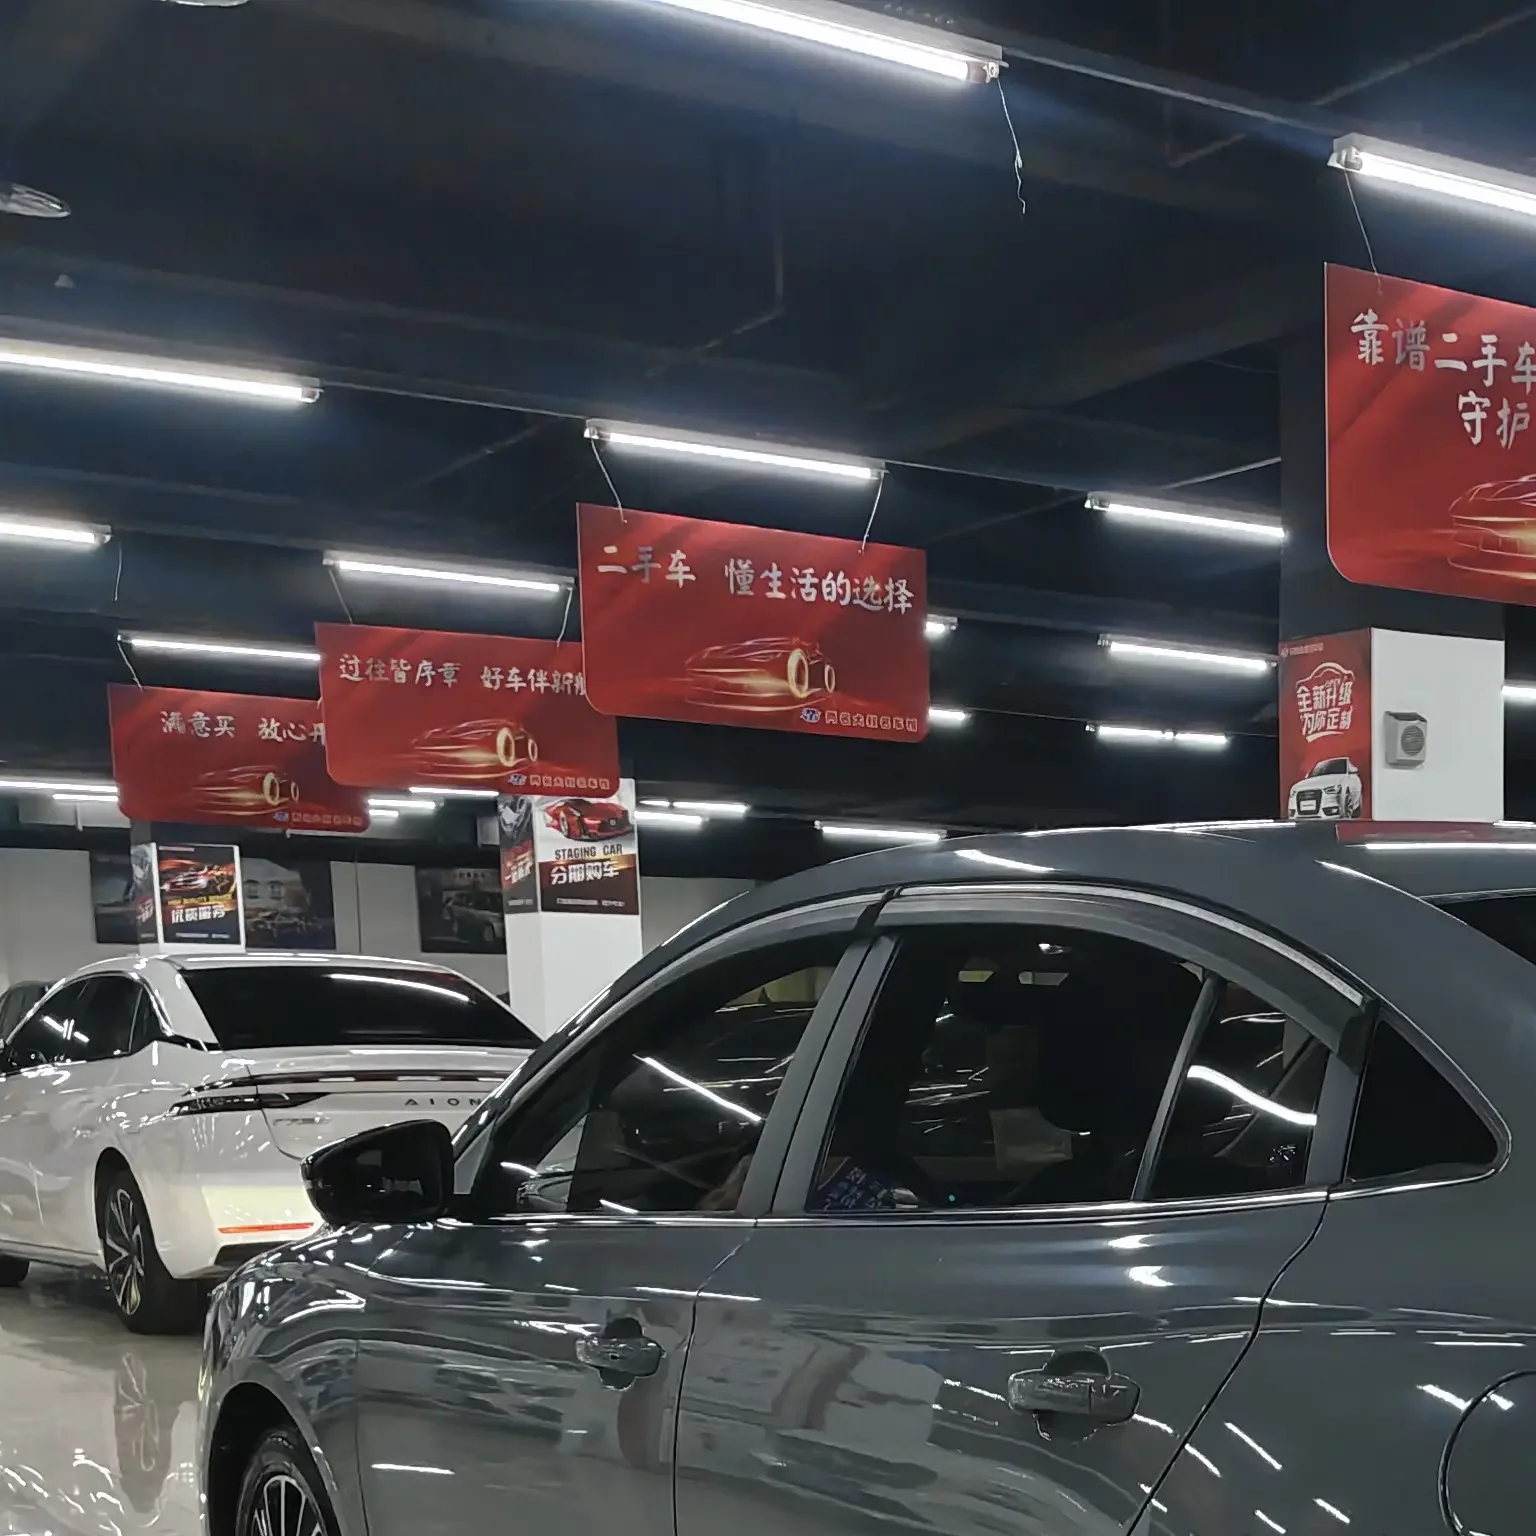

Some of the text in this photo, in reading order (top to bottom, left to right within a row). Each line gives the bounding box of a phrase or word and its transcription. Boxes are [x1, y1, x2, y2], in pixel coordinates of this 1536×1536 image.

[597, 545, 914, 615] 二手车 懂生活的选择
[338, 653, 461, 688] 过往皆序章
[1297, 679, 1354, 713] 全新升级
[160, 710, 236, 738] 满意买
[554, 843, 623, 861] STAGING CAR
[550, 861, 620, 885] 分期购车
